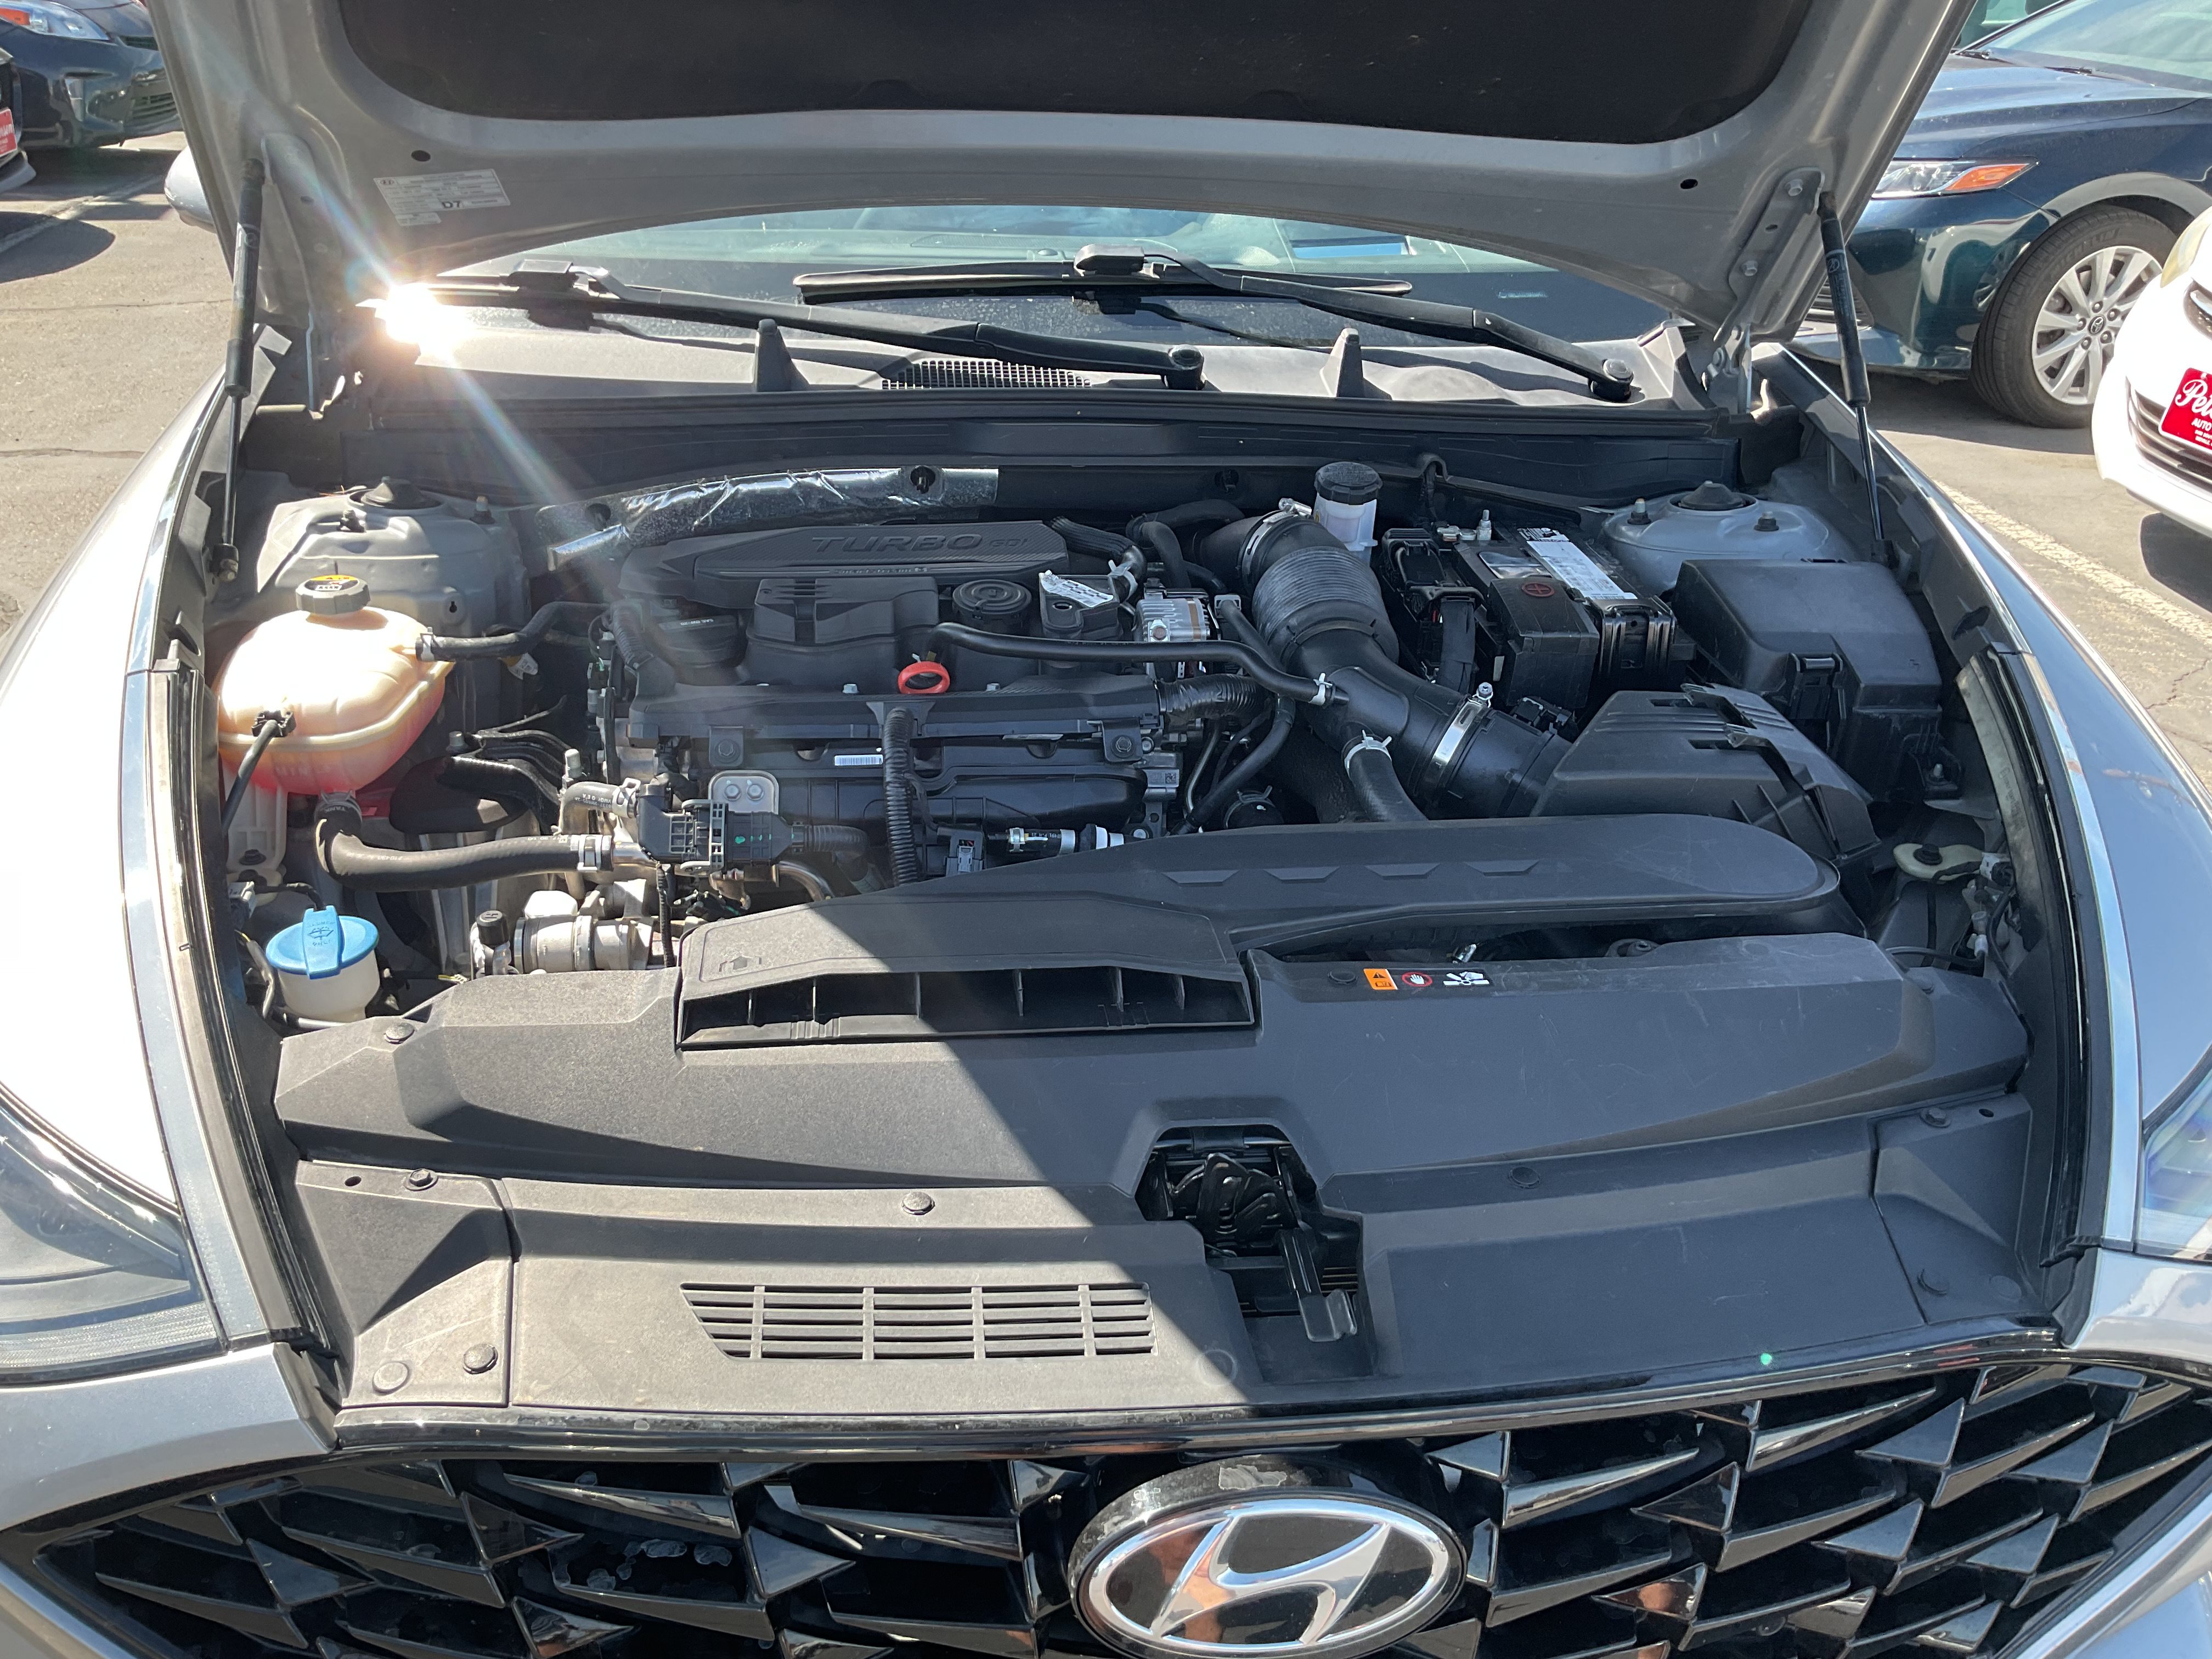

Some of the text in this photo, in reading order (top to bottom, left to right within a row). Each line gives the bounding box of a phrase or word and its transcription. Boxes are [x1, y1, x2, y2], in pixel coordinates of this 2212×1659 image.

[2175, 379, 2212, 419] Pet
[2191, 417, 2212, 432] AUTO
[812, 534, 982, 552] TURBO
